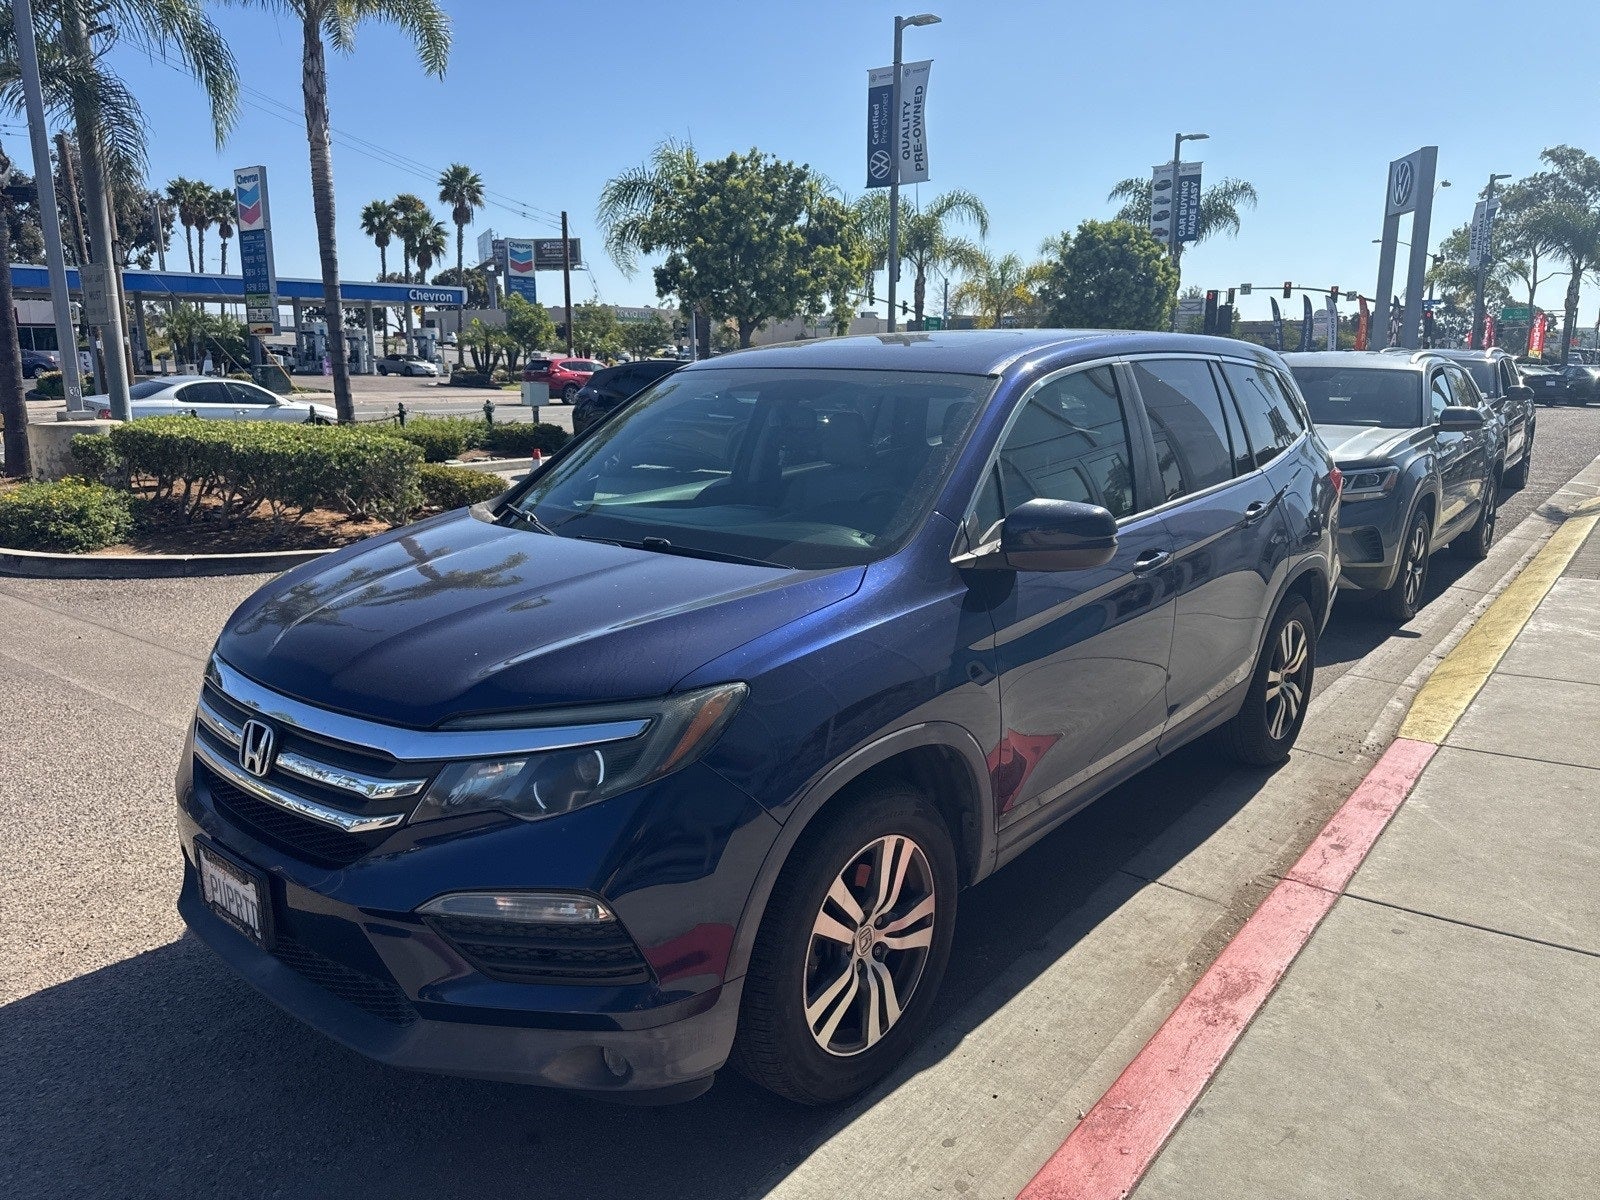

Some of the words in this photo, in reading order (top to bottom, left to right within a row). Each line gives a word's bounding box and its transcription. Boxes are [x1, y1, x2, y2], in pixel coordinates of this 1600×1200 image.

[881, 93, 889, 144] Pre-Owned
[902, 101, 911, 160] QUALITY
[913, 85, 924, 172] PRE-OWNED
[236, 173, 259, 184] Chevron
[1180, 181, 1189, 216] BUYING
[1190, 181, 1199, 206] EASY
[1178, 218, 1187, 237] CAR
[1188, 208, 1197, 234] MADE
[508, 241, 533, 250] Chevron
[408, 288, 453, 302] Chevron
